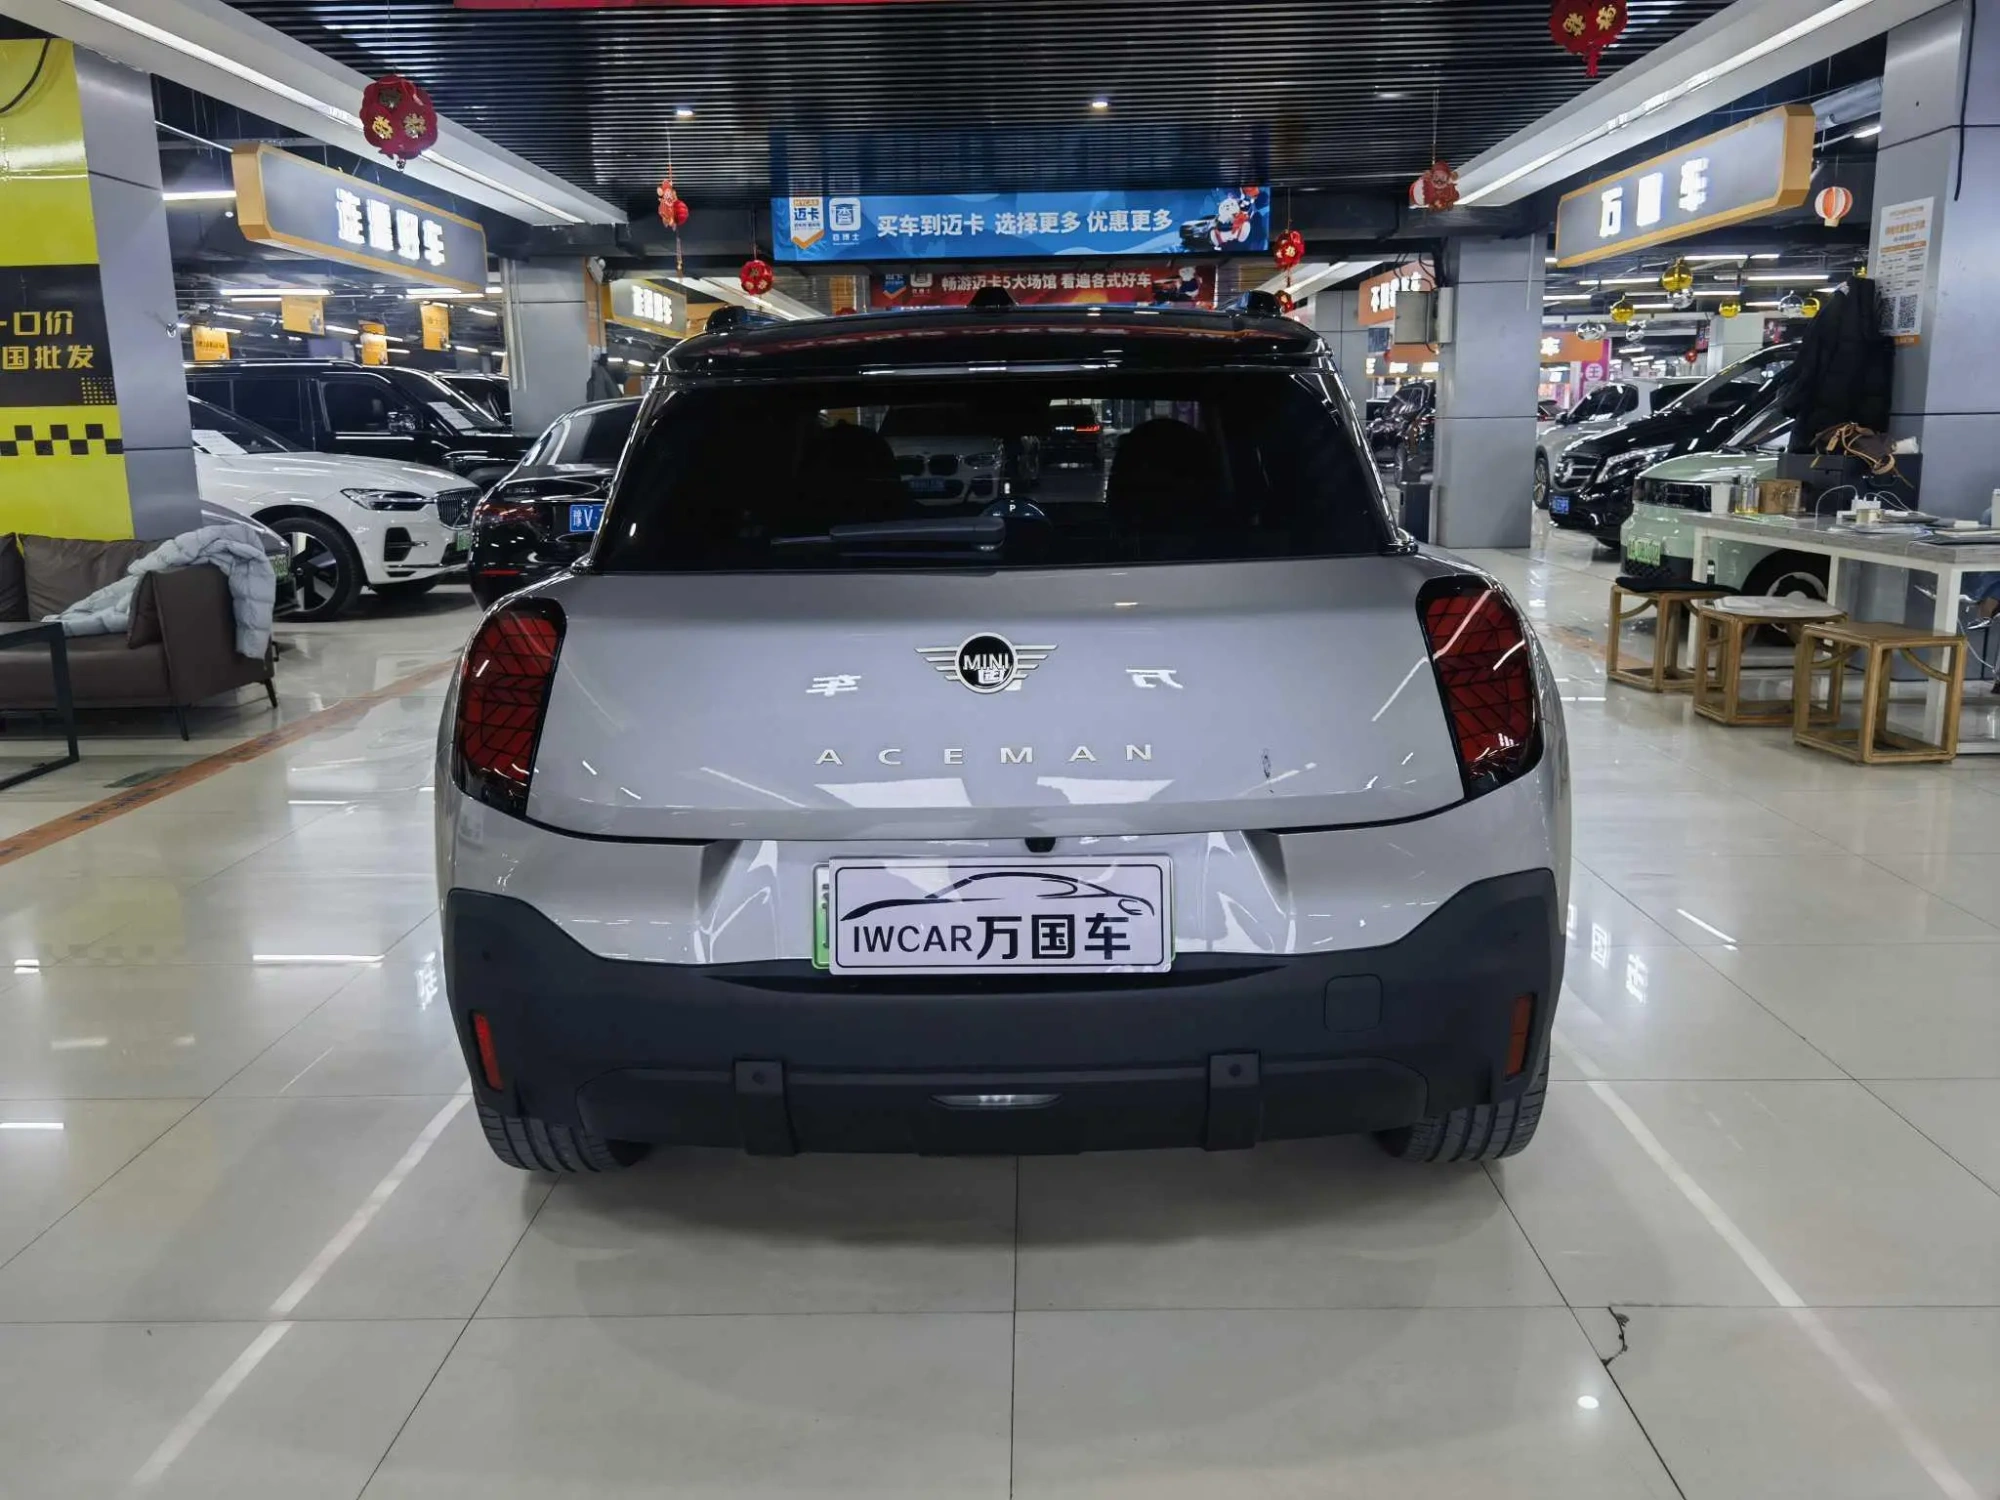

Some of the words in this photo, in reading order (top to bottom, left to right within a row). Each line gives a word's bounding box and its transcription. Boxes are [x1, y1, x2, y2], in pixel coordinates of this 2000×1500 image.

[793, 207, 820, 221] 迈卡
[877, 213, 985, 237] 买车到迈卡
[995, 211, 1081, 235] 选择更多
[1087, 209, 1173, 233] 优惠更多
[941, 273, 1057, 291] 畅游迈卡5大场馆
[1061, 272, 1151, 290] 看遍各式好车
[2, 344, 95, 370] 国批发
[963, 653, 1010, 671] MINI
[815, 744, 1153, 765] ACEMAN
